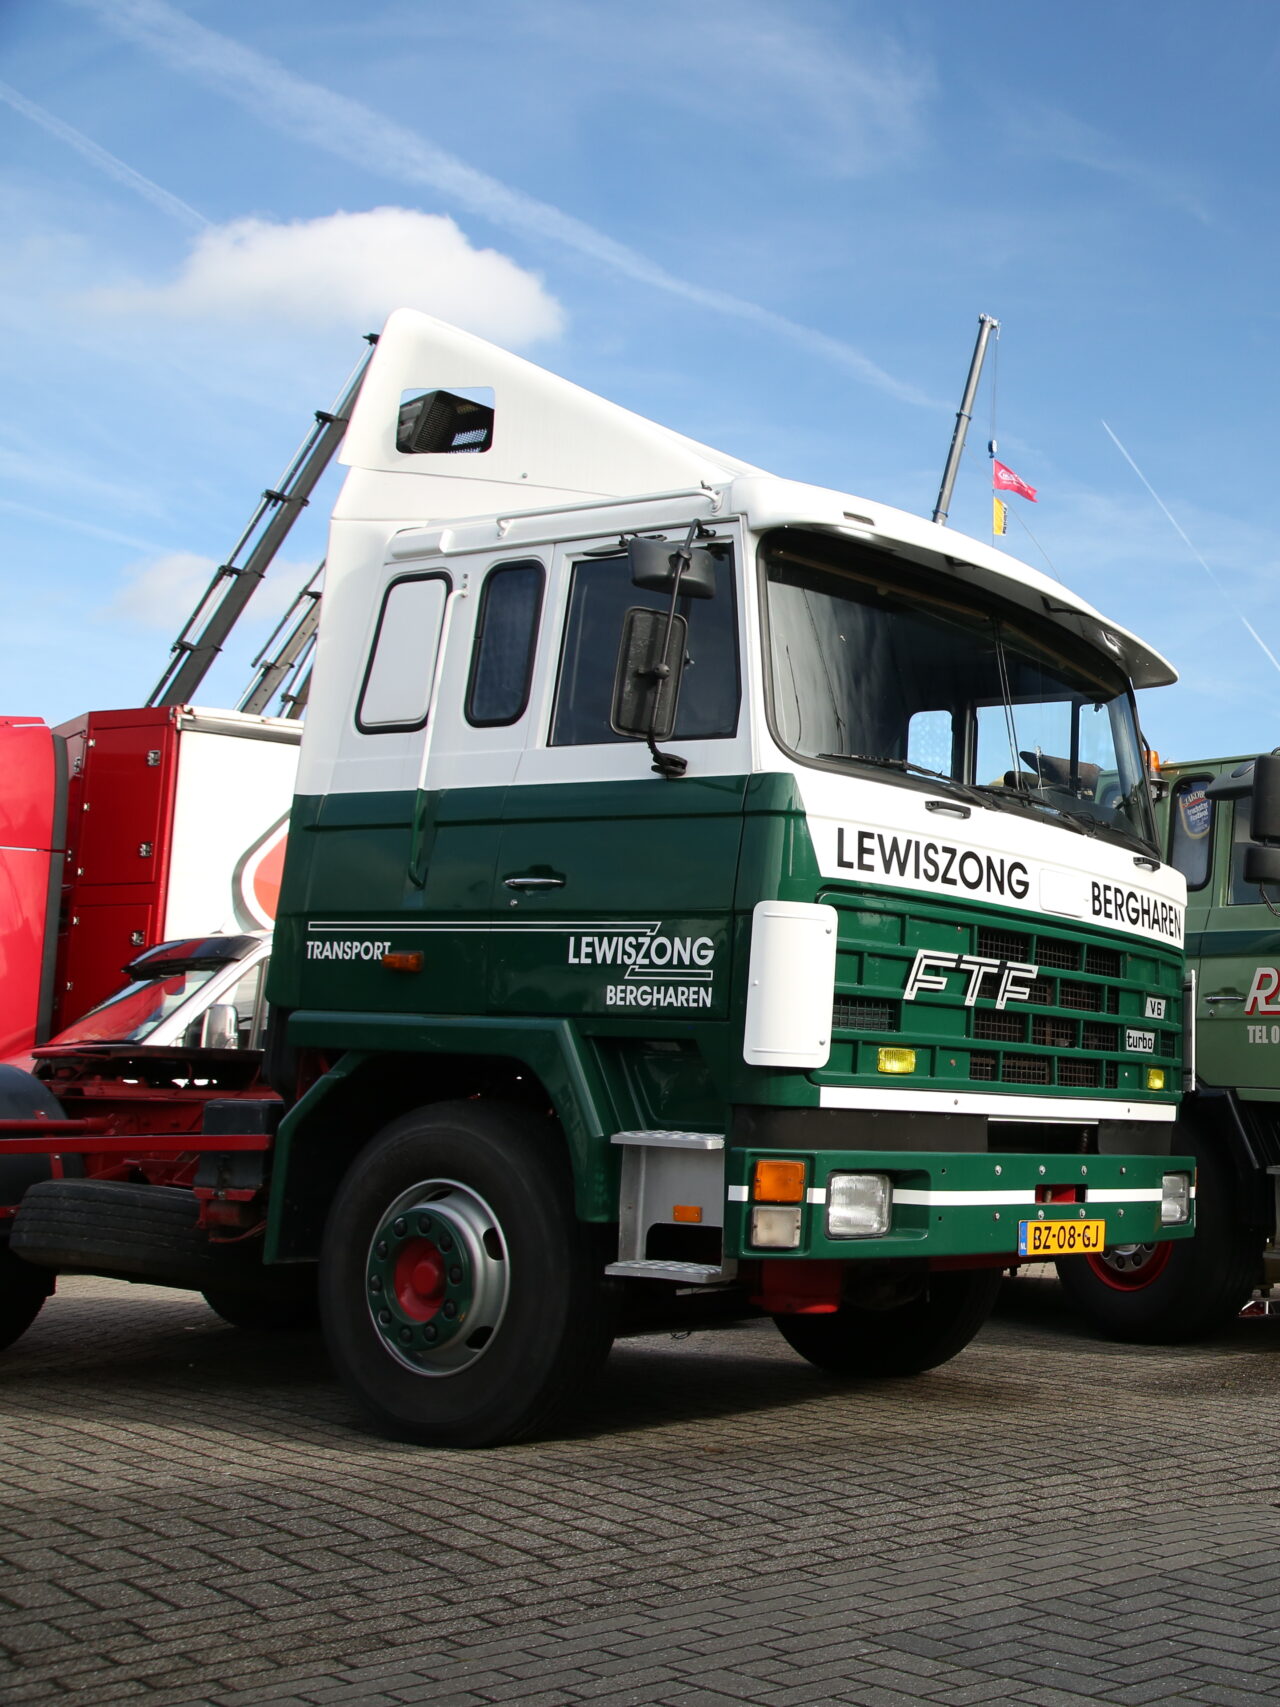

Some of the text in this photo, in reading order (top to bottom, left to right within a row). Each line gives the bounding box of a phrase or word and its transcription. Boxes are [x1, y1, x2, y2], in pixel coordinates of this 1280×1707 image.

[837, 827, 1182, 941] LEWISZONG BERGHAREN
[306, 941, 391, 960] TRANSPORT
[568, 936, 715, 966] LEWISZONG
[903, 949, 1039, 1010] FTF
[605, 985, 713, 1007] BERGHAREN
[1149, 1000, 1162, 1017] V6
[1126, 1031, 1153, 1050] turbo
[1247, 1025, 1268, 1044] TEL
[1033, 1225, 1099, 1250] BZ-08-GJ
